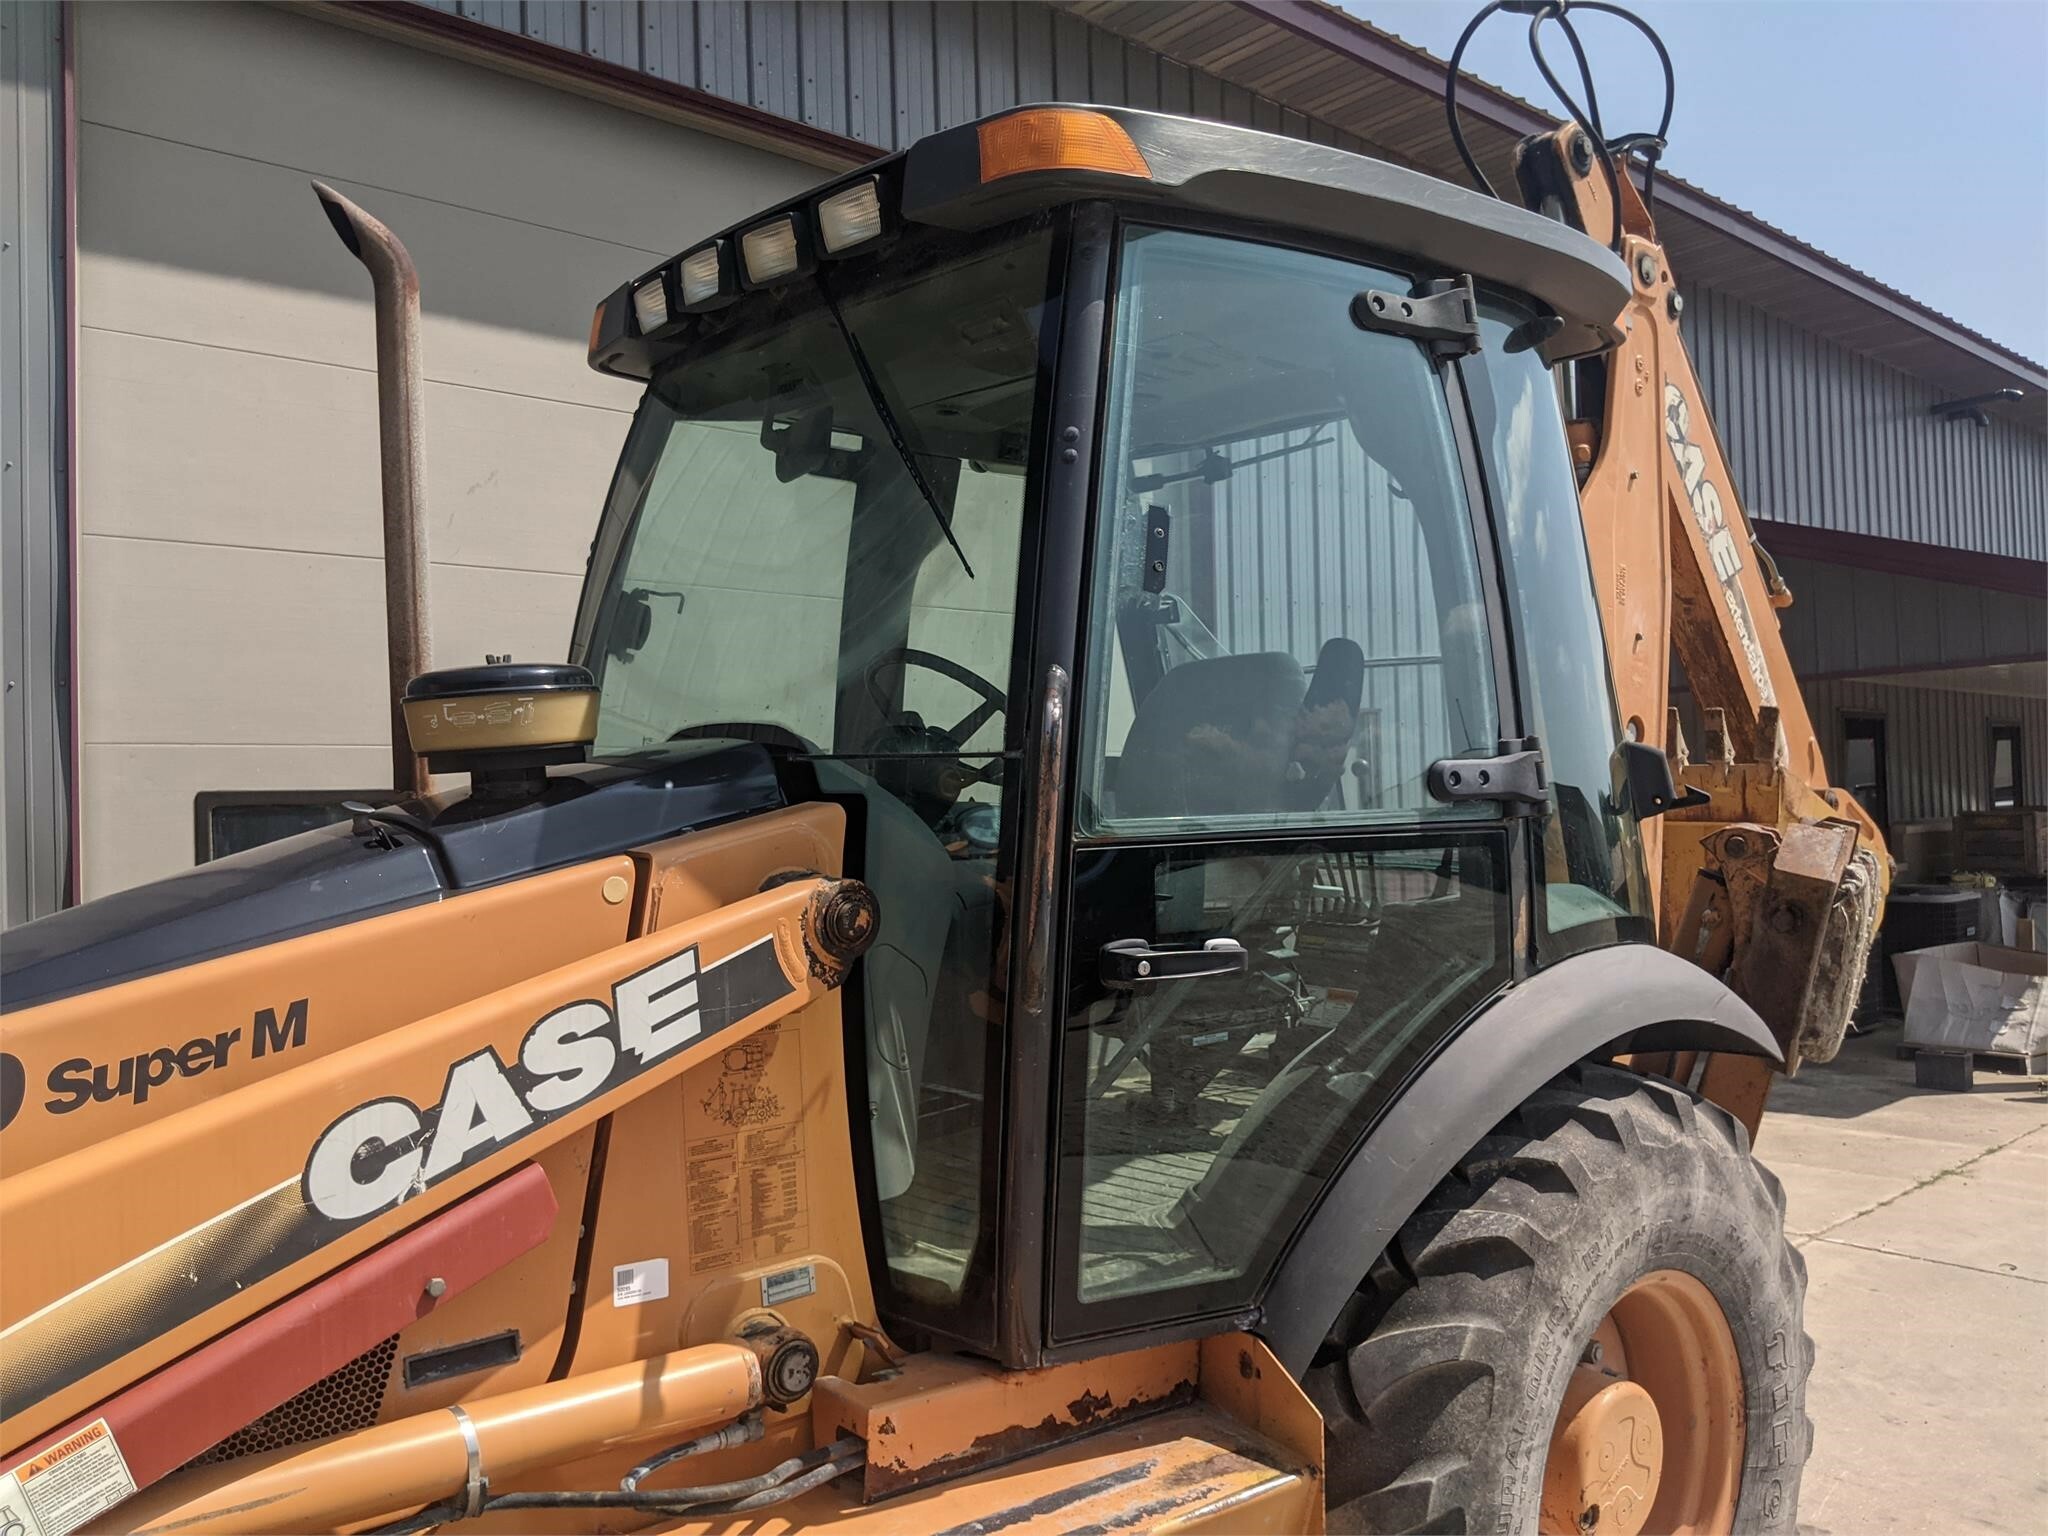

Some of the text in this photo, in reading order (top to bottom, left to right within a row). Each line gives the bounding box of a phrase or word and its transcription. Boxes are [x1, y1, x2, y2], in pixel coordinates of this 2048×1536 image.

[1664, 384, 1743, 583] CASE
[45, 1027, 241, 1115] Super
[251, 998, 309, 1059] M
[307, 945, 702, 1220] CASE
[43, 1427, 103, 1466] WARNING
